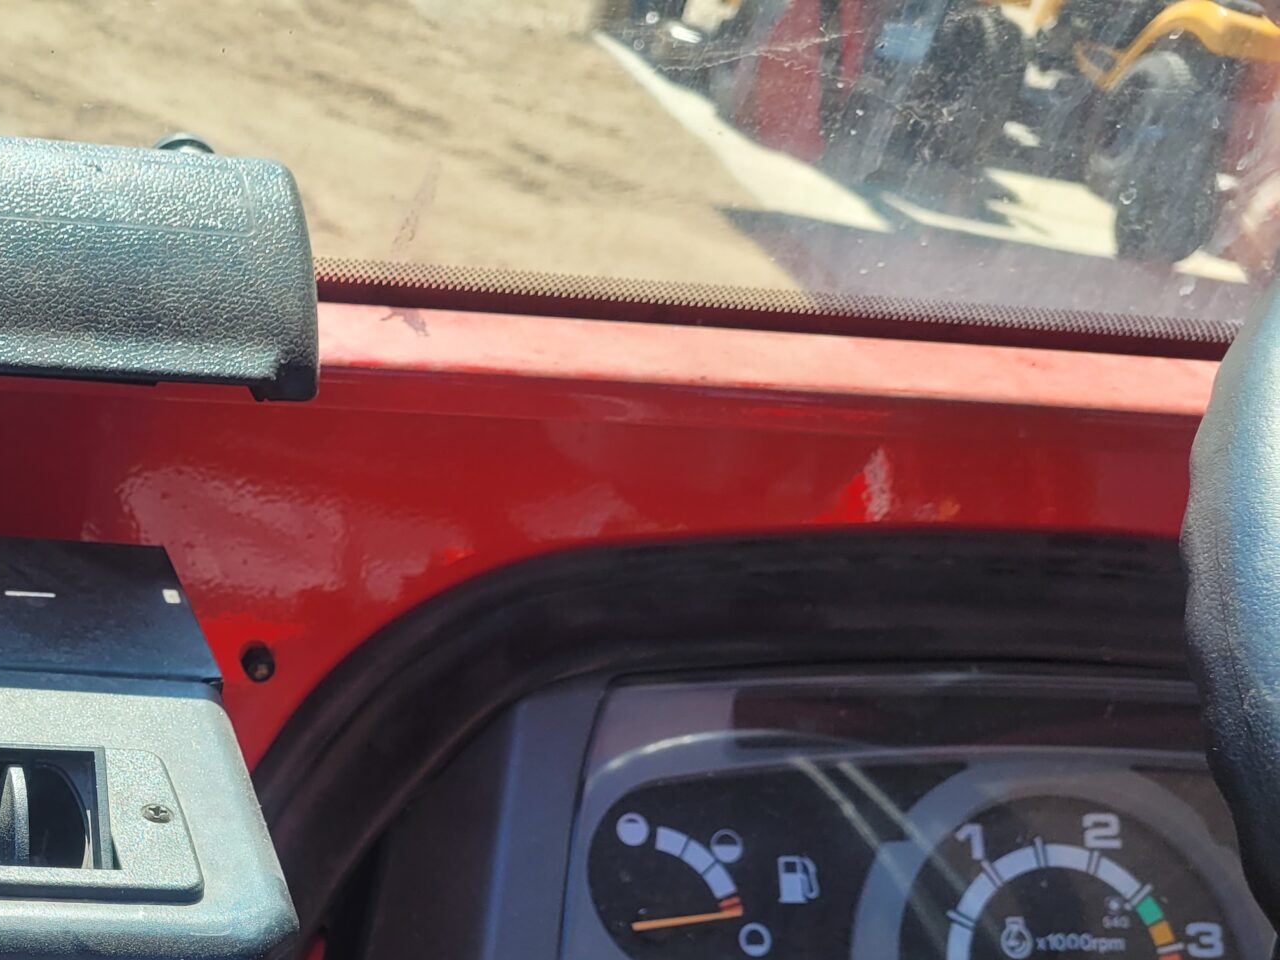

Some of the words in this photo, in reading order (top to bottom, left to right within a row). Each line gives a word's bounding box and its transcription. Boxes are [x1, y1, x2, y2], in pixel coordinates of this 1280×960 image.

[955, 823, 986, 860] 1
[1082, 813, 1123, 849] 2
[1036, 932, 1125, 953] x1000rpm
[1185, 922, 1224, 959] 3
